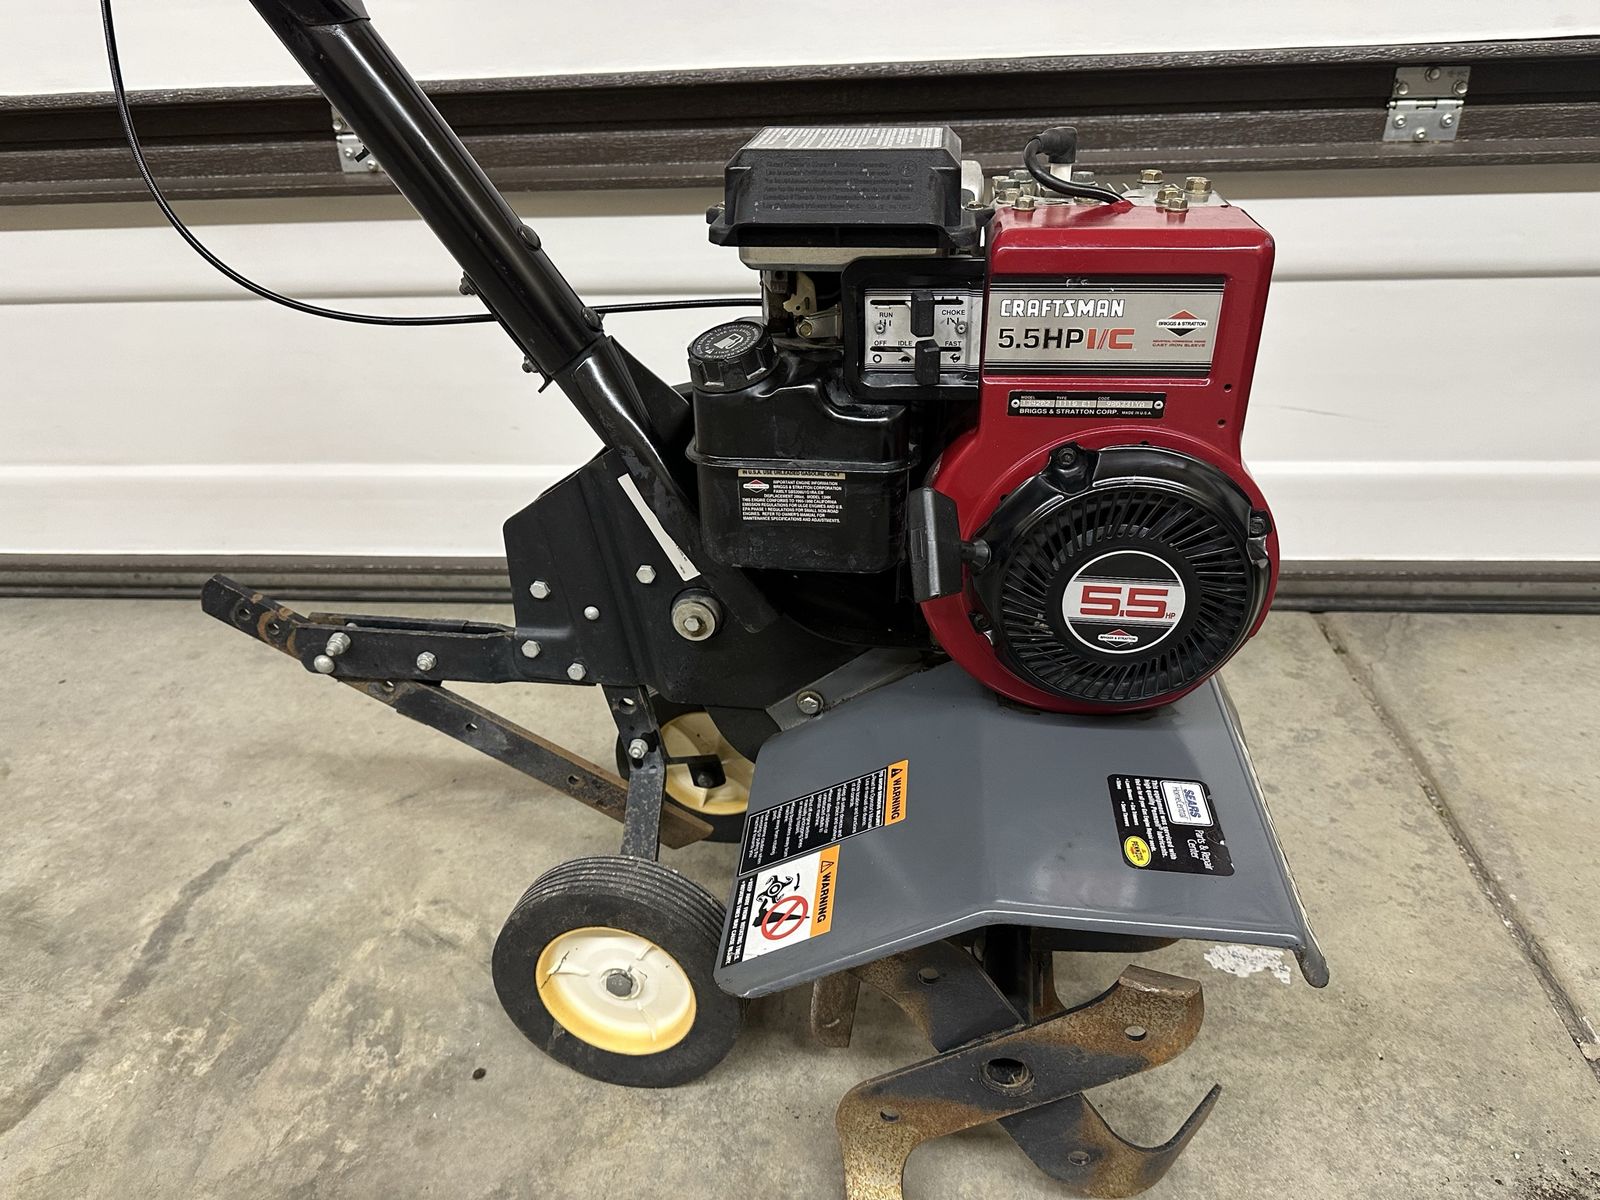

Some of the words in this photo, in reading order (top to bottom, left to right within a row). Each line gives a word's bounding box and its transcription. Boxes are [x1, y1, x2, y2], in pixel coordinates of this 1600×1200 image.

[1000, 298, 1126, 318] CRAFTSMAN
[1080, 585, 1169, 619] 5.5
[891, 777, 900, 820] WARNING
[1183, 788, 1201, 818] SEARS
[1186, 838, 1200, 859] Center
[1194, 829, 1206, 843] Parts
[1198, 851, 1214, 870] Repair
[816, 871, 830, 923] WARNING
